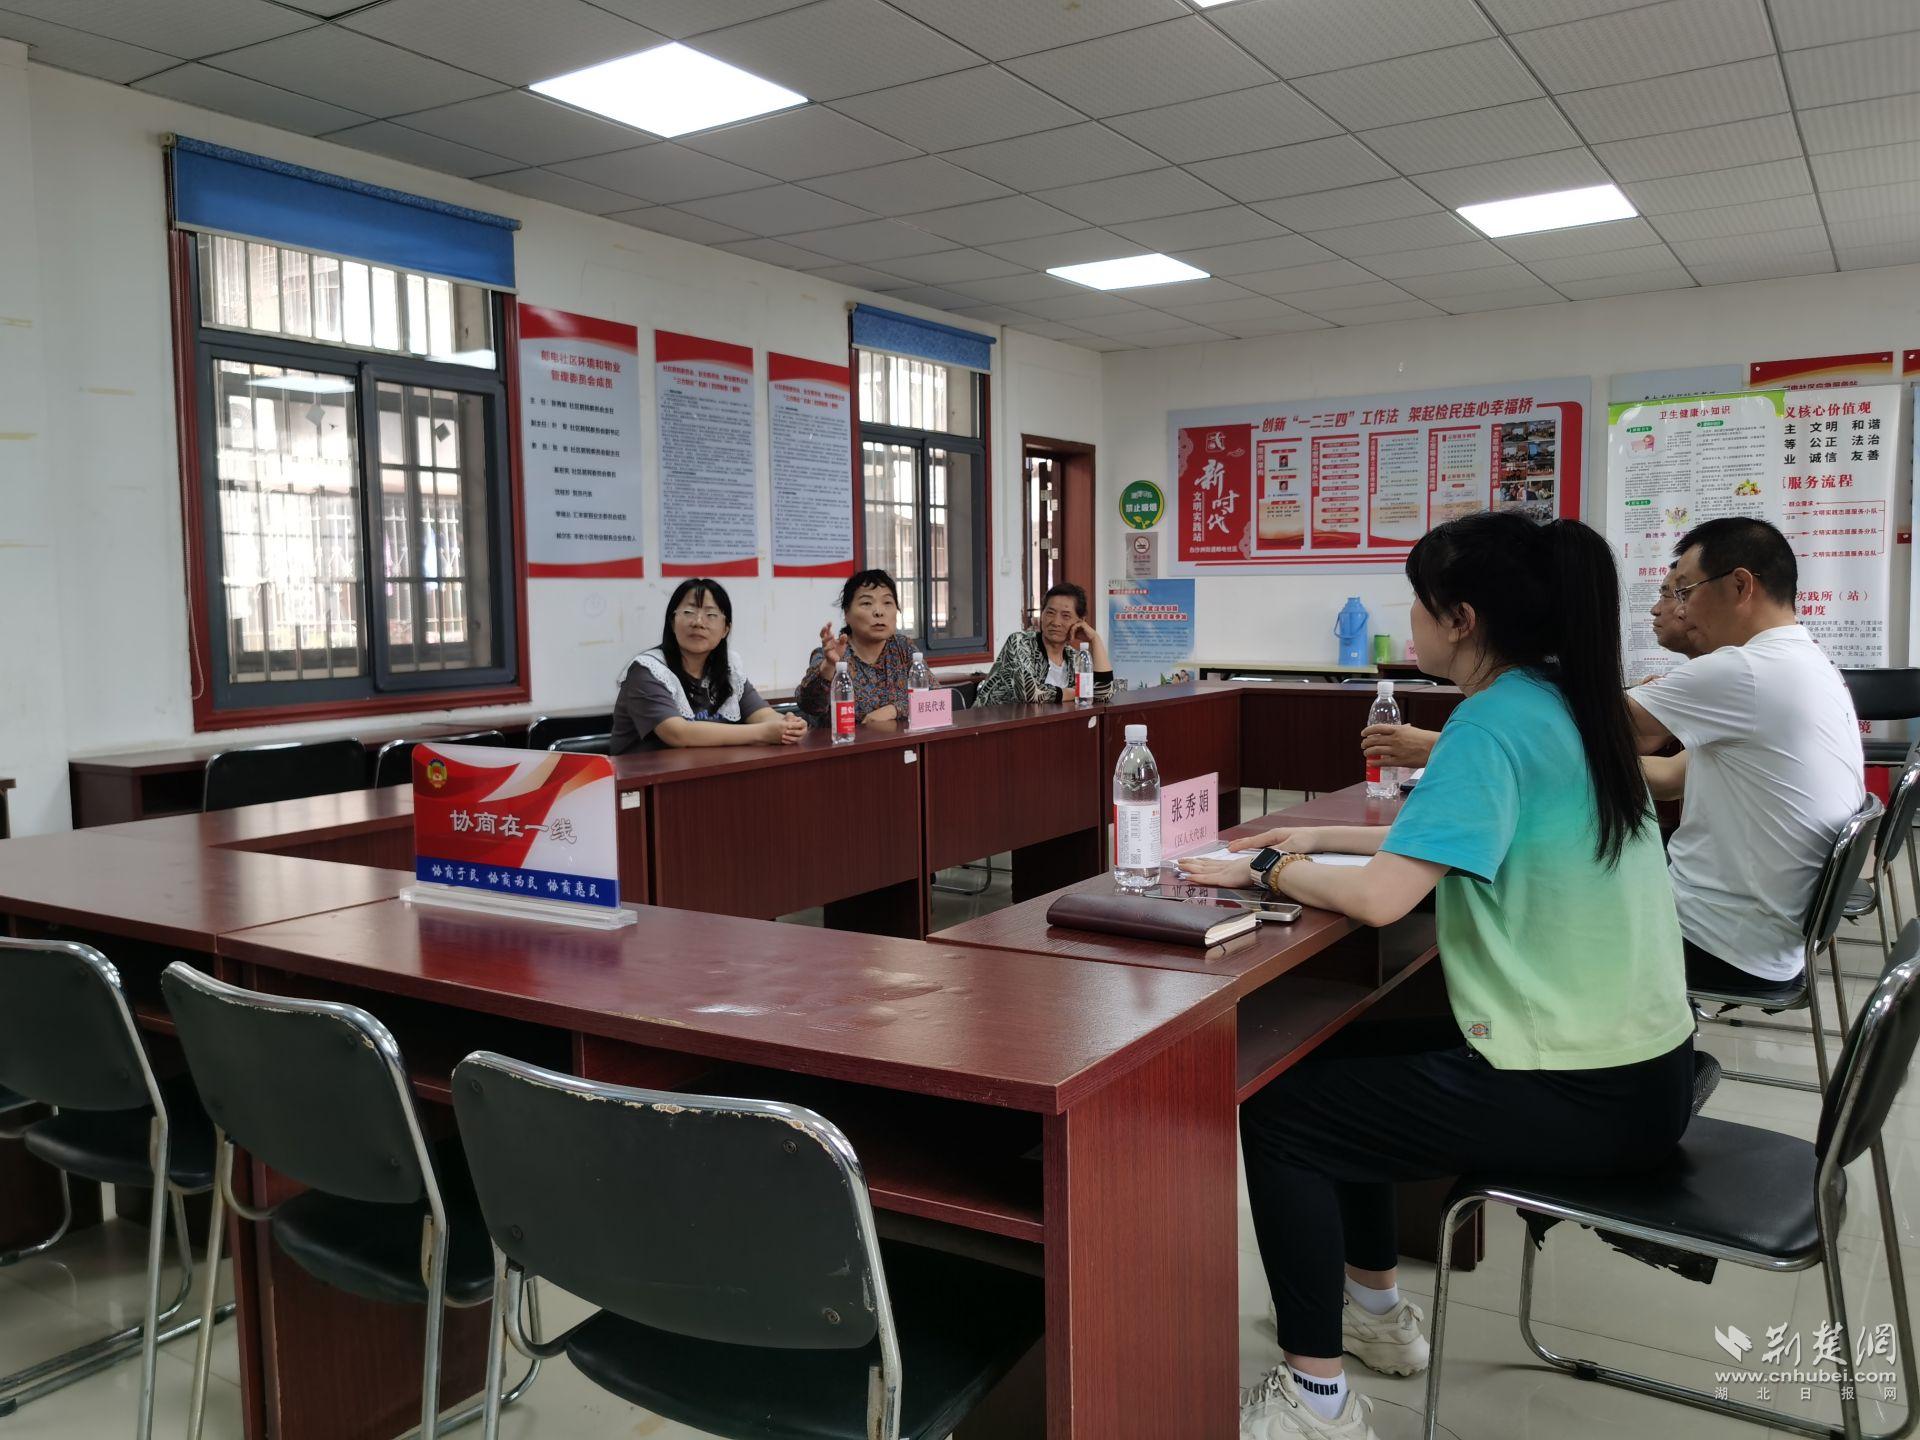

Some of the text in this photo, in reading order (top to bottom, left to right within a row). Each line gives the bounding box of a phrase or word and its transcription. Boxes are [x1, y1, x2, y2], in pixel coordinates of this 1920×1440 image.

[1408, 397, 1534, 423] 架起检民连心幸福桥
[1659, 405, 1731, 420] 卫生健康小知识
[1784, 401, 1872, 420] 义核心价值观
[1784, 418, 1881, 435] 主 文明 和谐
[1784, 434, 1880, 450] 等 公正 法治
[1784, 450, 1880, 465] 业 诚信 友善
[1783, 474, 1854, 490] 服务流程
[1796, 605, 1826, 616] 制度
[918, 700, 946, 713] 居民代表
[1171, 789, 1209, 824] 张秀娟
[449, 809, 578, 844] 协商在一线
[431, 864, 600, 898] 协商于民 协商为民 协商惠民
[1293, 1372, 1339, 1396] PUMA
